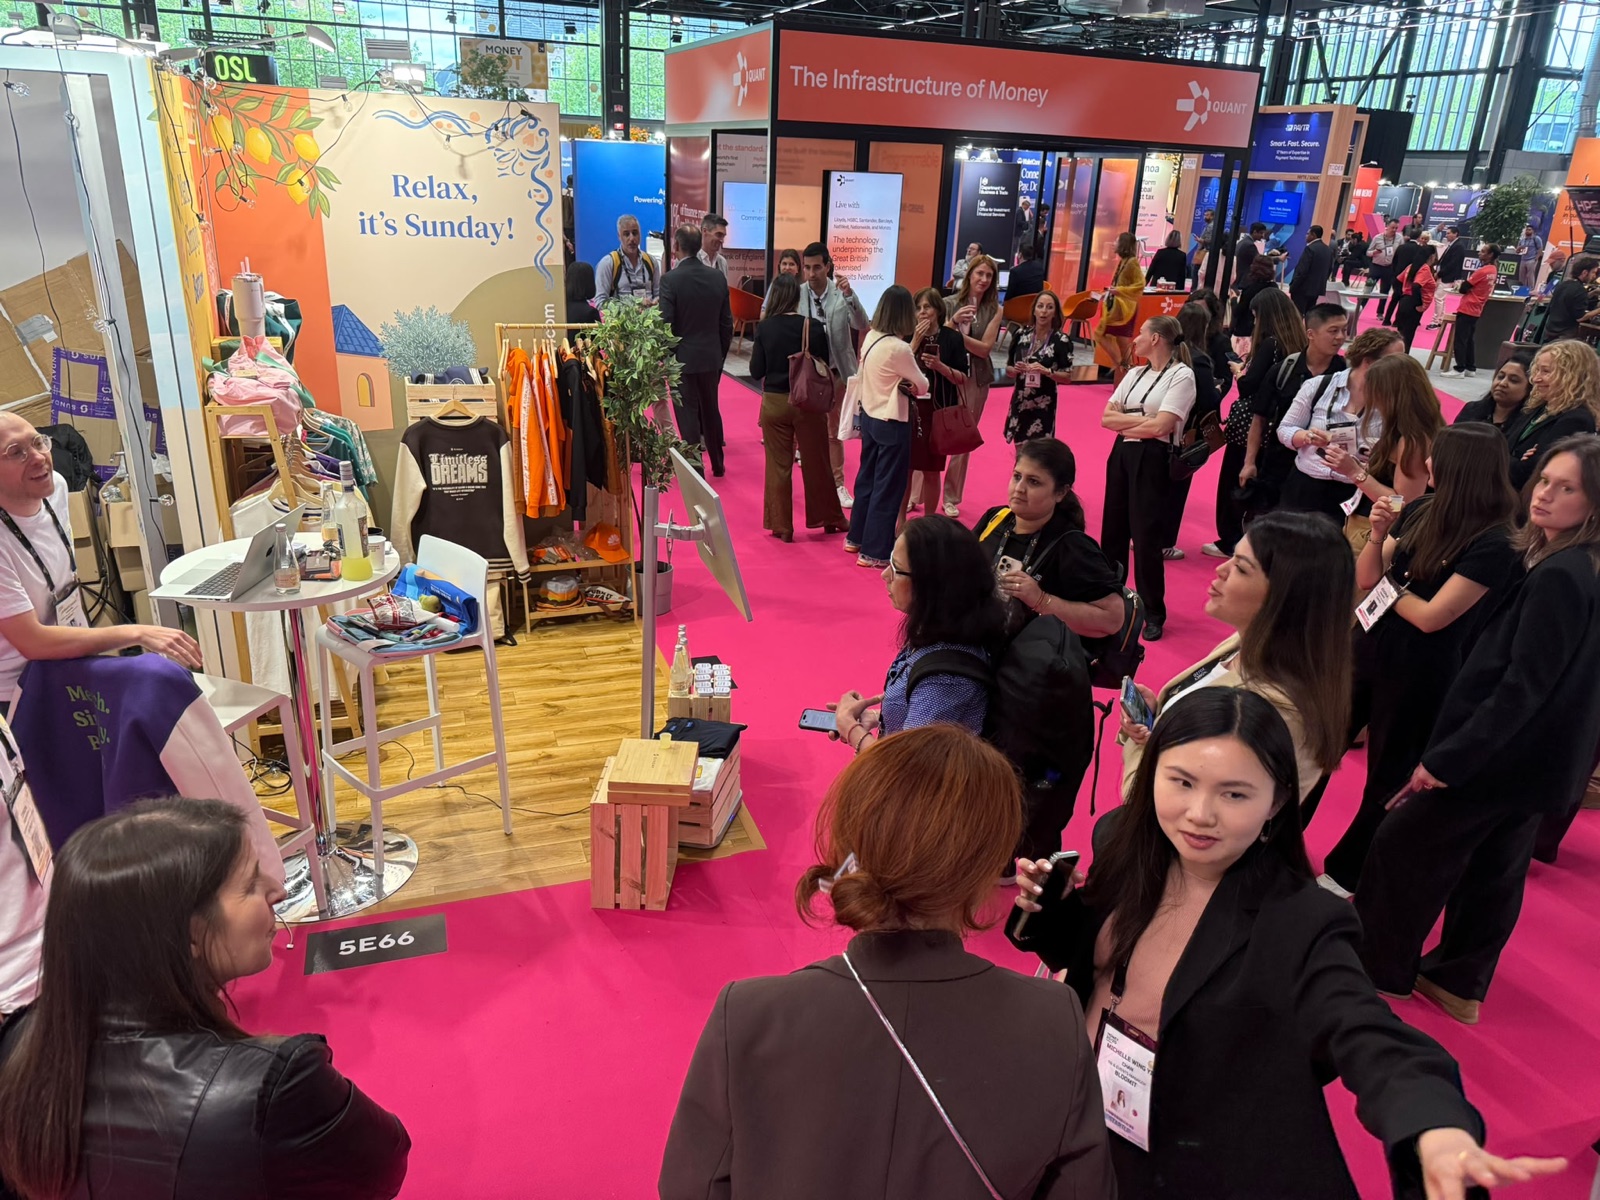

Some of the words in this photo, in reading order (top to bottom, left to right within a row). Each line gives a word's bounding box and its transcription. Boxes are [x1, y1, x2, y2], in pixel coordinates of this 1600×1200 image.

[485, 45, 522, 55] MONEY
[214, 54, 257, 83] OSL
[748, 67, 766, 82] QUANT
[789, 65, 828, 88] The
[833, 69, 962, 97] Infrastructure
[966, 79, 986, 99] of
[988, 80, 1049, 107] Money
[1212, 101, 1247, 114] QUANT
[391, 174, 478, 205] Relax,
[634, 196, 663, 205] Powering
[835, 200, 848, 208] Live
[358, 210, 398, 236] it’s
[405, 213, 514, 246] Sunday!
[833, 236, 846, 244] The
[846, 236, 880, 246] technology
[832, 246, 872, 254] underpinning
[428, 453, 488, 466] Limitless
[431, 462, 488, 486] DREAMS
[338, 931, 415, 956] 5E66
[1106, 1042, 1132, 1062] MICHELLE
[1131, 1058, 1146, 1072] WING
[1122, 1061, 1134, 1072] CHAN
[1114, 1070, 1138, 1088] BLOOMIT
